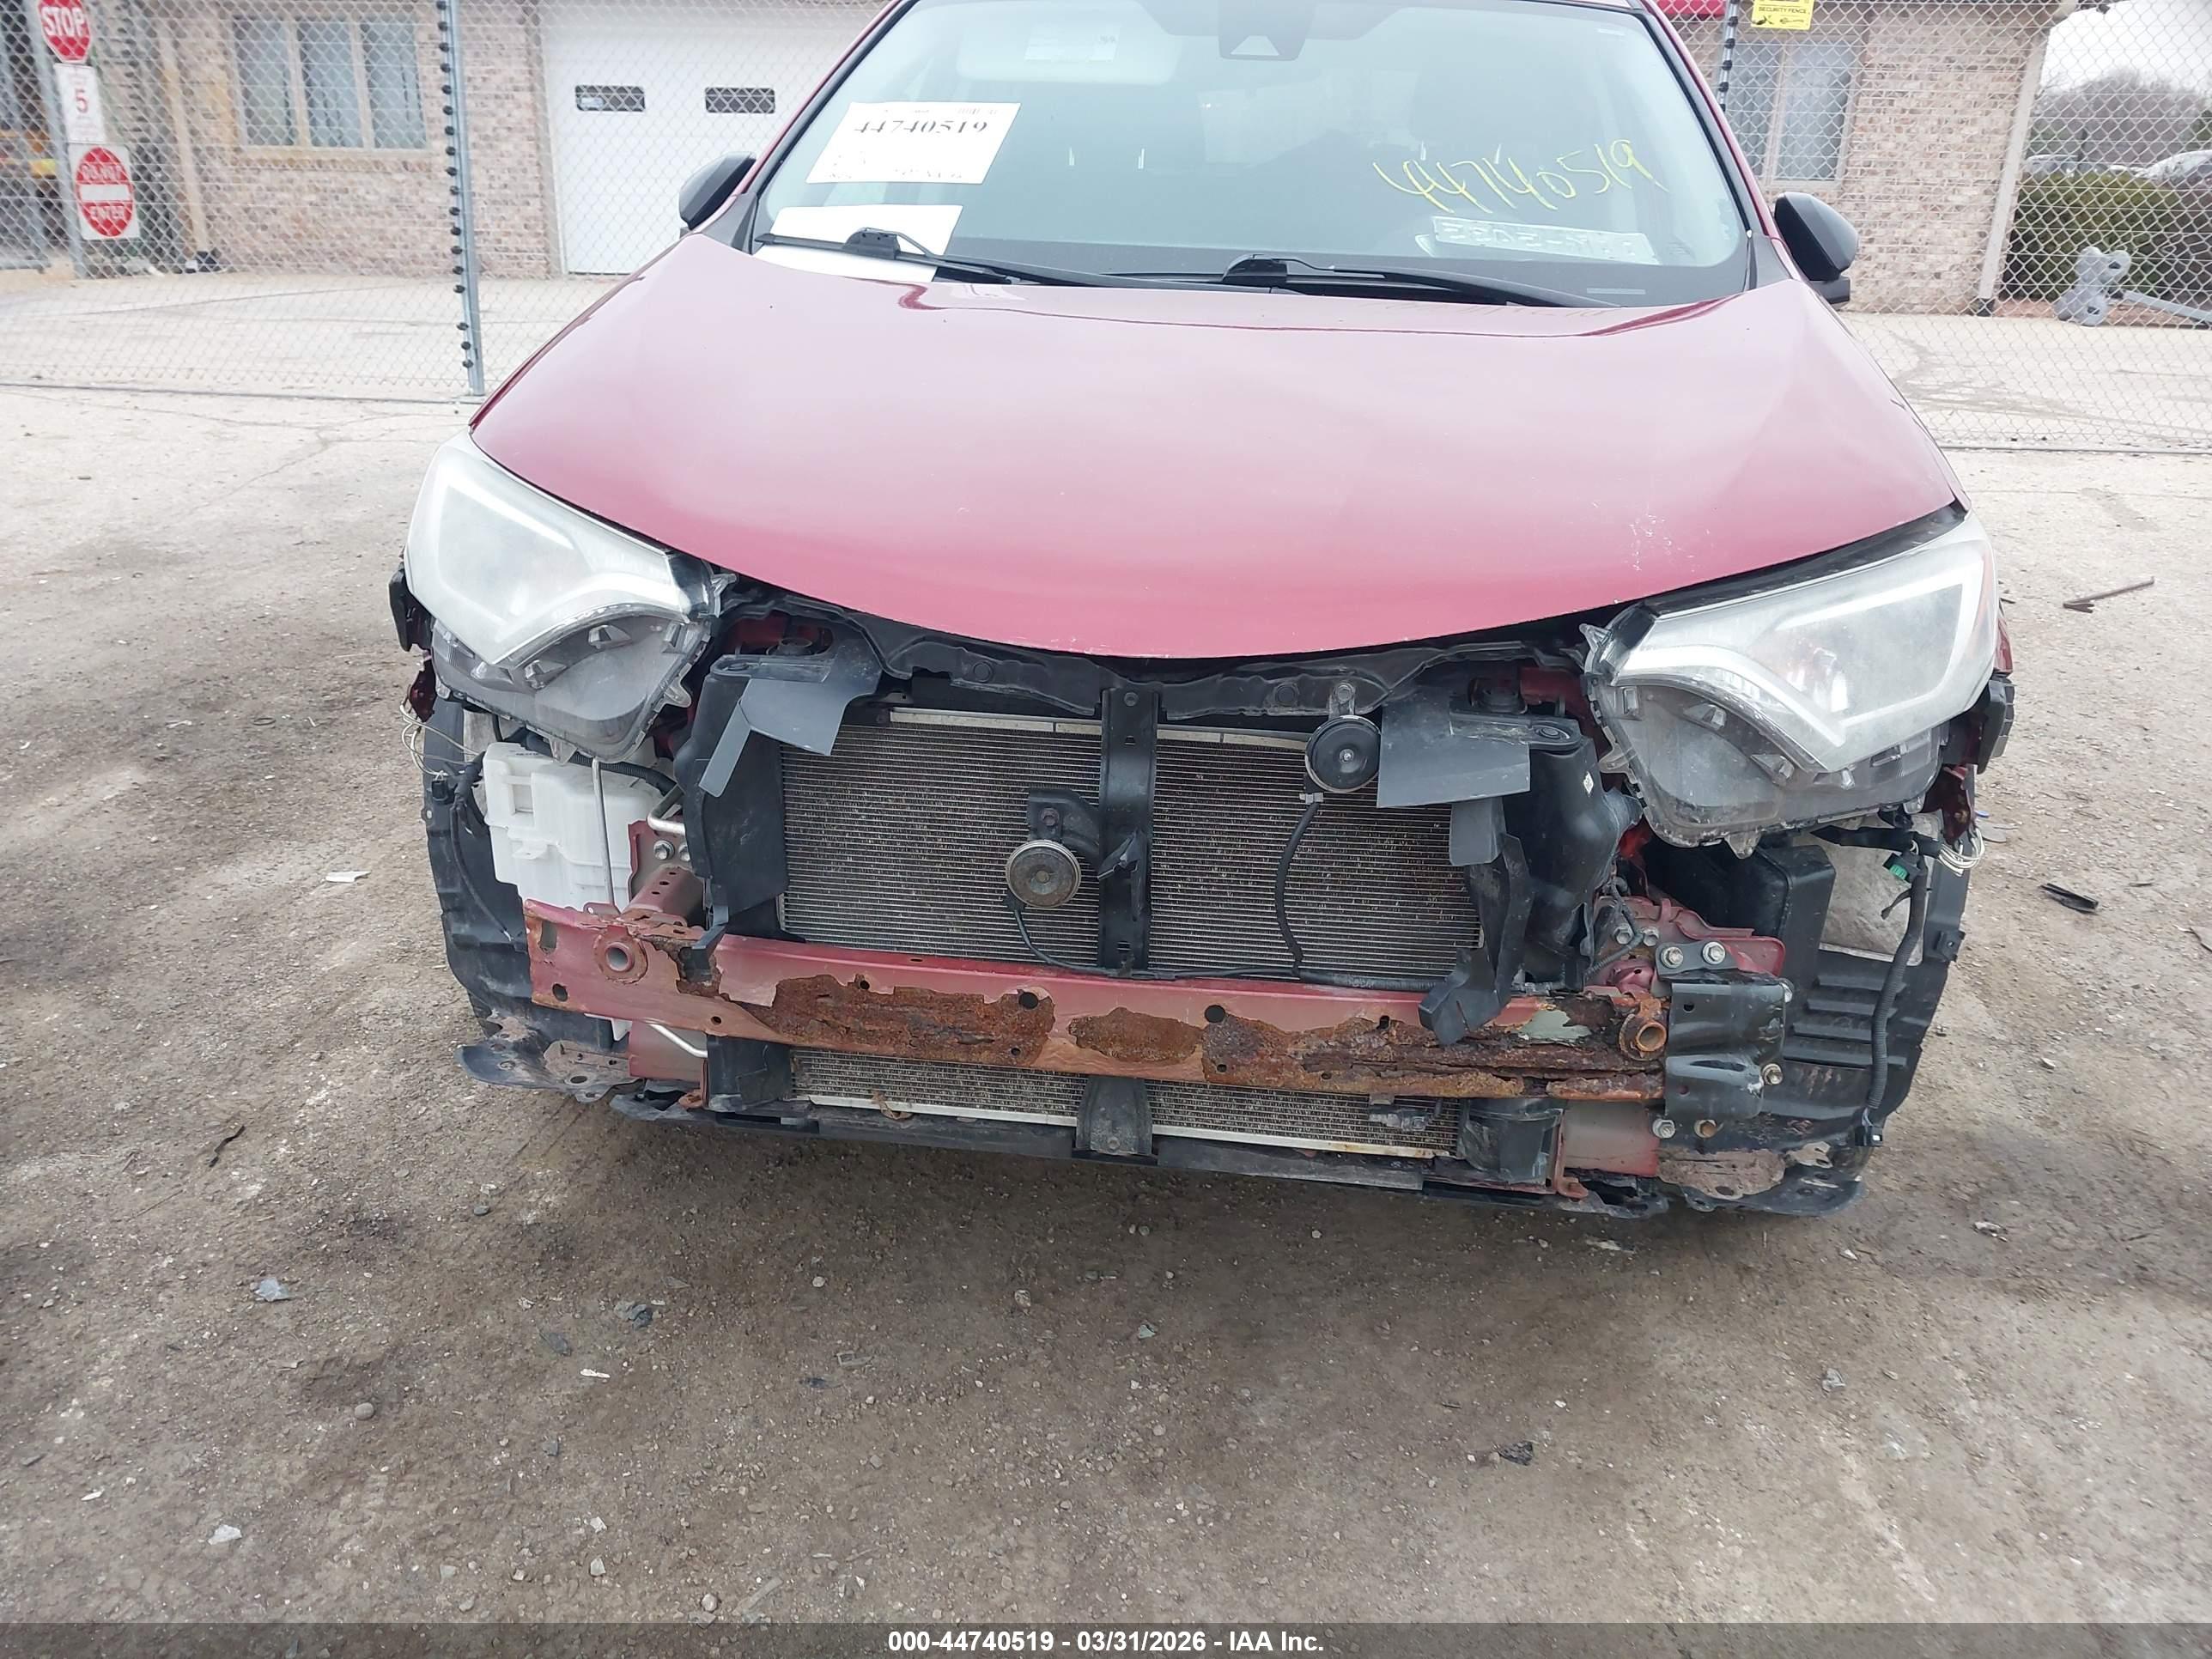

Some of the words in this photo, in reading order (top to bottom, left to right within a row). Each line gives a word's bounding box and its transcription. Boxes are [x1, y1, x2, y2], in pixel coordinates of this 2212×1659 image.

[41, 6, 85, 37] STOP
[75, 88, 88, 113] 5
[854, 120, 988, 134] 44740519
[81, 164, 98, 179] DO
[99, 164, 123, 180] NOT
[1372, 139, 1670, 214] 44740519
[89, 205, 125, 220] ENTER
